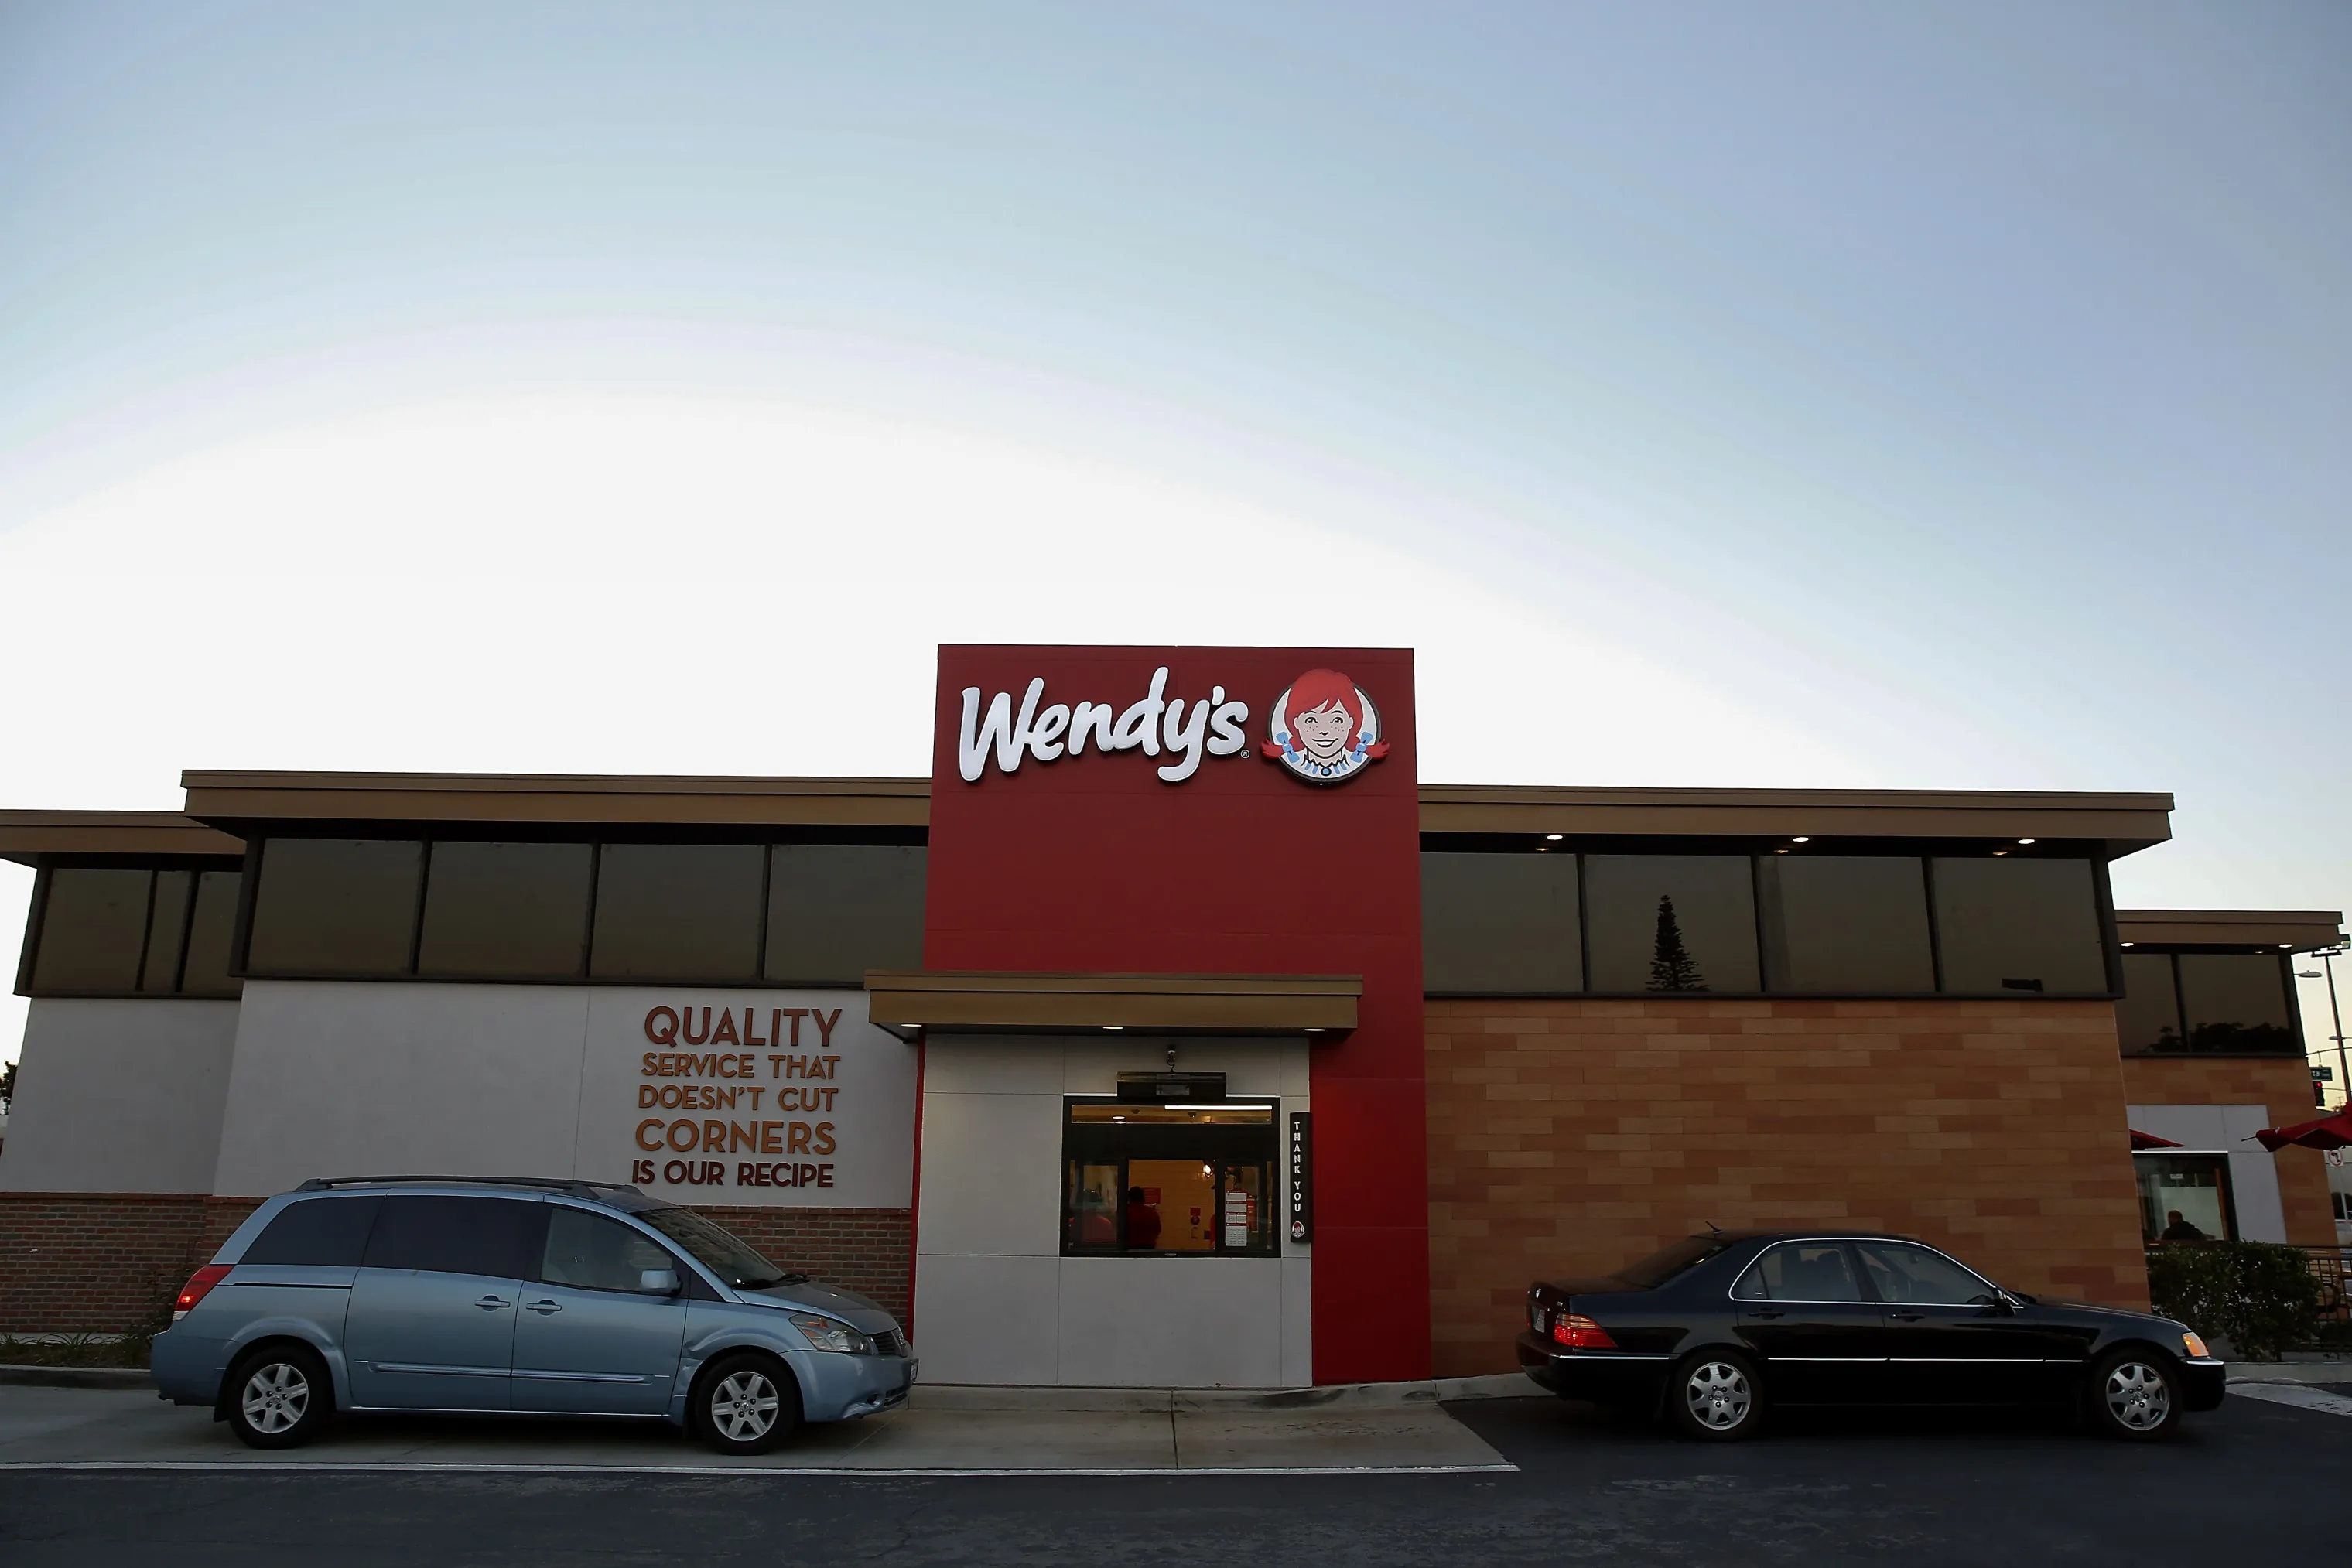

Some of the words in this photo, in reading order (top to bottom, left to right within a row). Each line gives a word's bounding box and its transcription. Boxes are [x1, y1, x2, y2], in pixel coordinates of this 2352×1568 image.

[959, 666, 1250, 781] Wendy's
[644, 1005, 843, 1048] QUALITY
[641, 1052, 755, 1078] SERVICE
[768, 1054, 841, 1079] THAT
[638, 1085, 765, 1111] DOESN'T
[778, 1086, 839, 1112] CUT
[635, 1118, 836, 1156] CORNERS
[631, 1159, 655, 1184] IS
[663, 1160, 725, 1186] OUR
[737, 1161, 834, 1188] RECIPE
[1294, 1180, 1302, 1212] YOU
